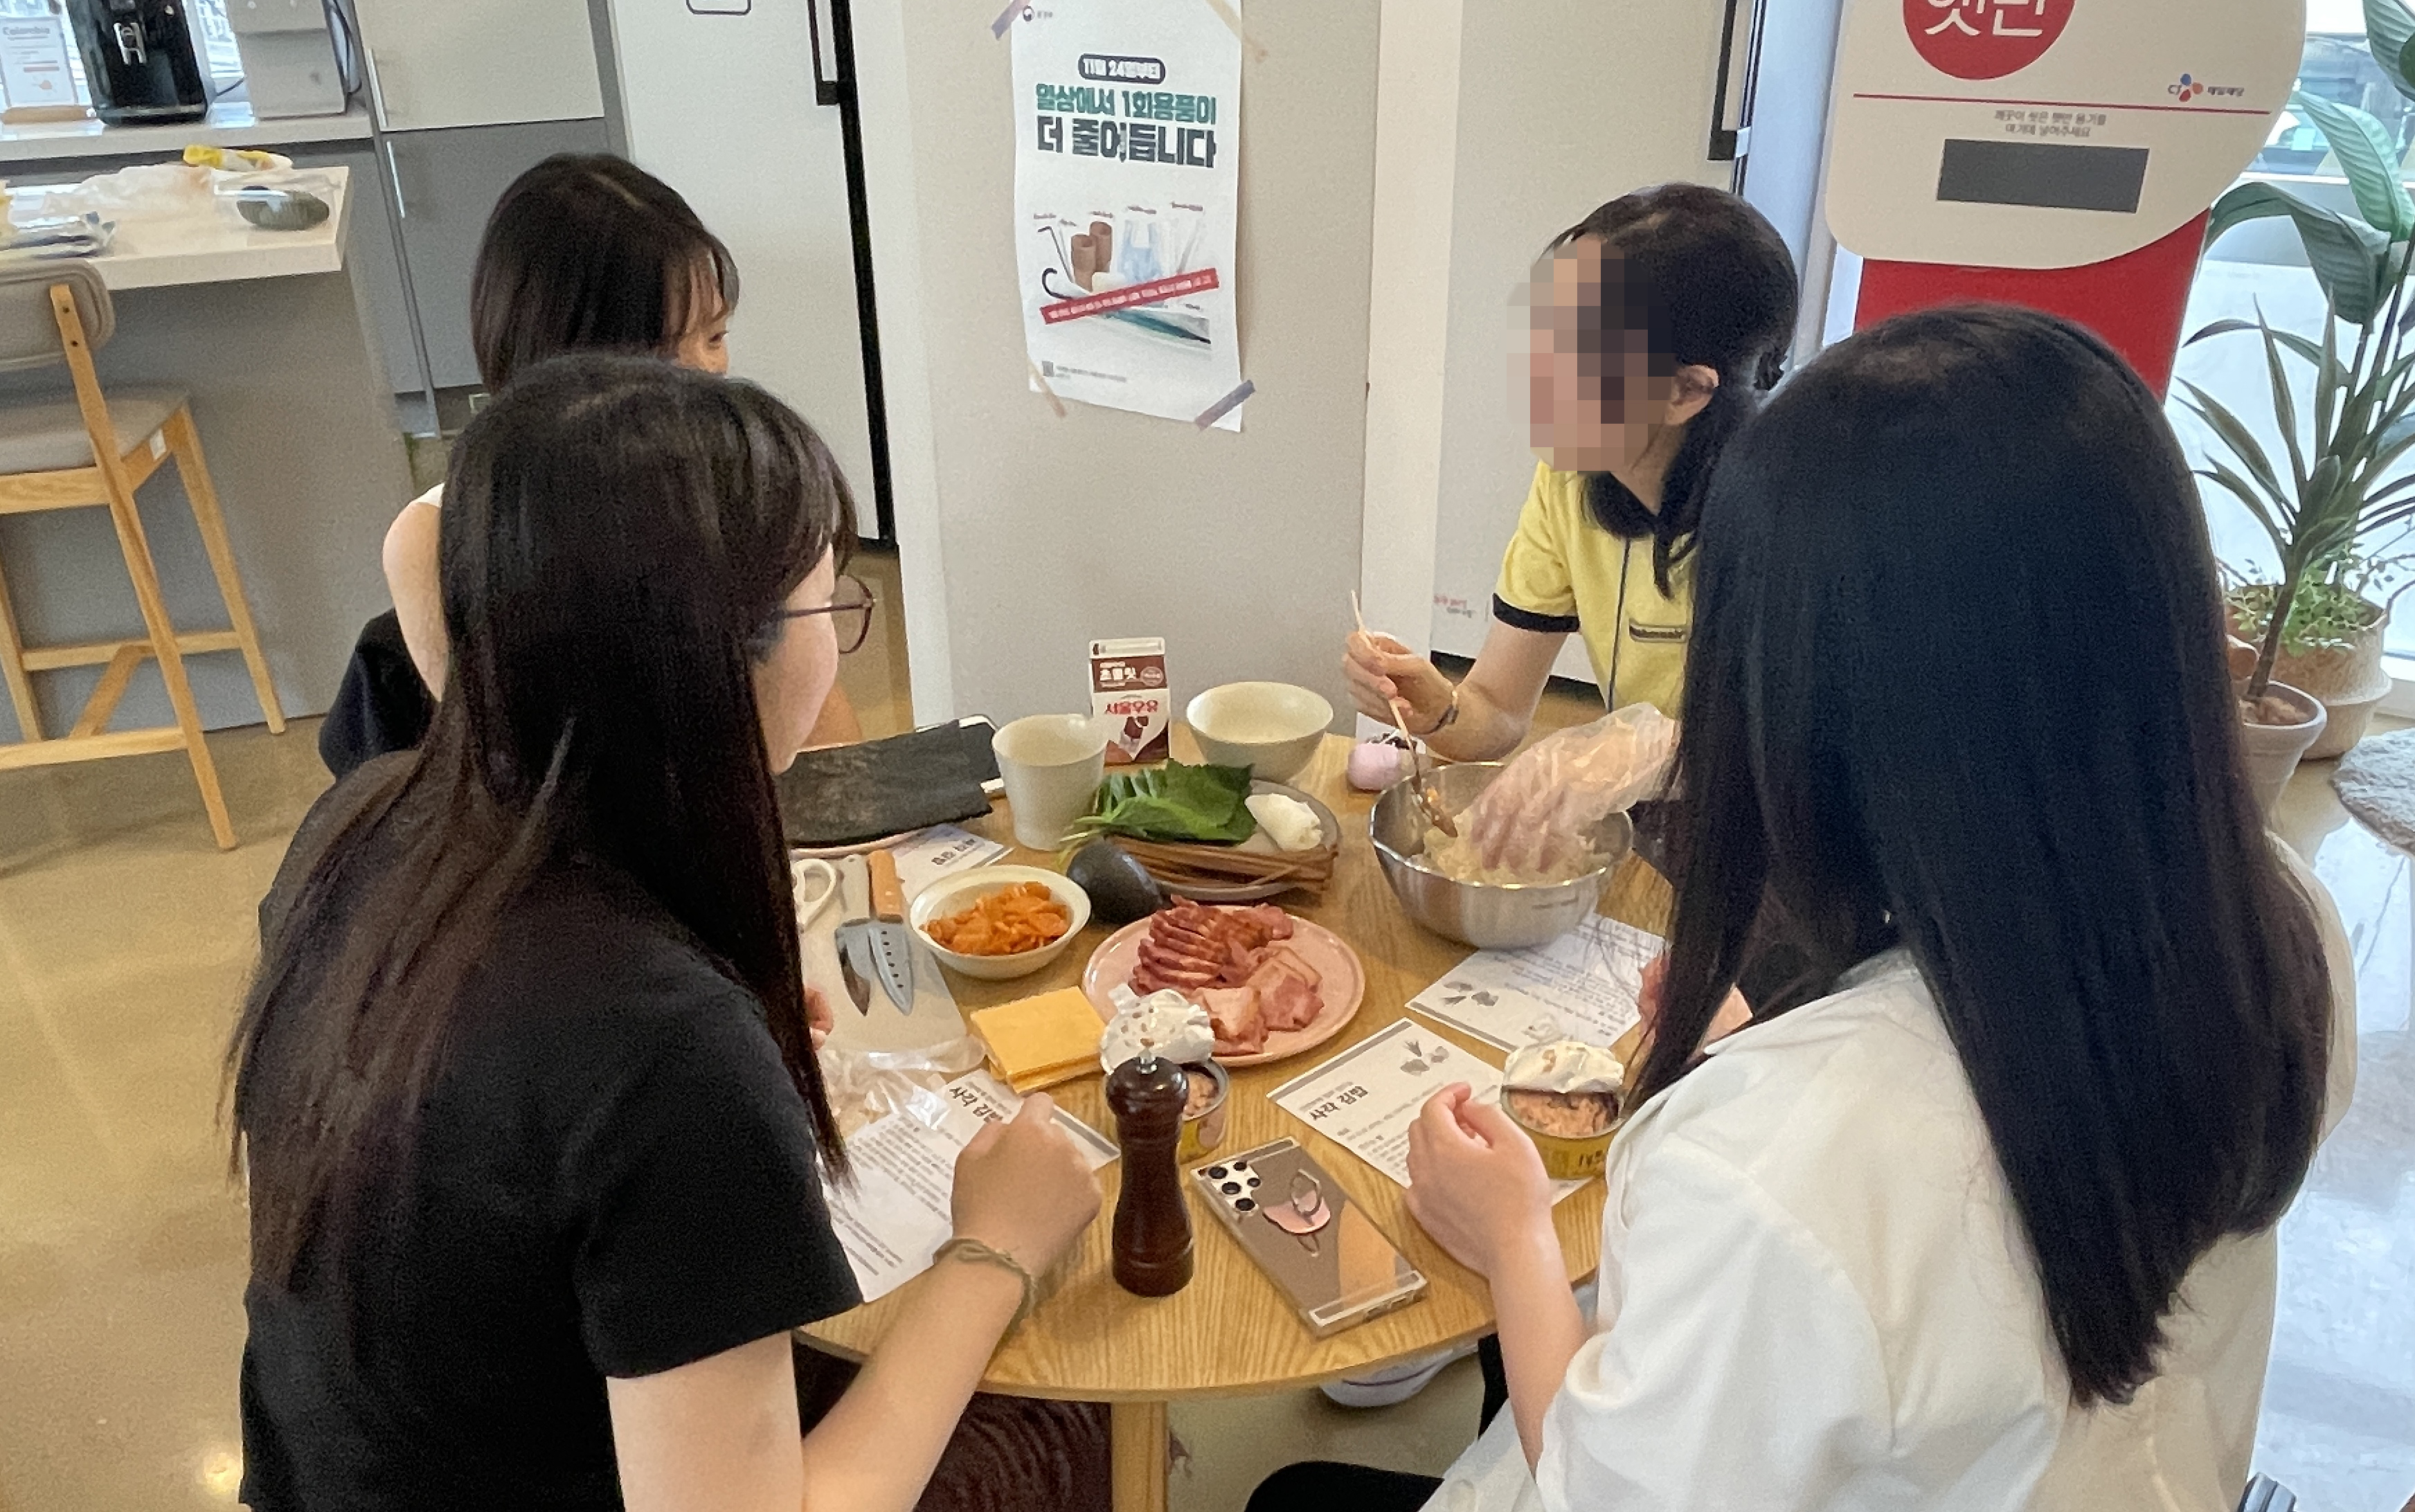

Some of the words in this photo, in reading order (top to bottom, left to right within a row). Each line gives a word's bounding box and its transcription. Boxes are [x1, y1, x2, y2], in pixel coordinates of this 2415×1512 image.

[1036, 83, 1115, 116] 일상에서
[1122, 90, 1217, 125] 1회용품이
[1037, 116, 1063, 153] 더
